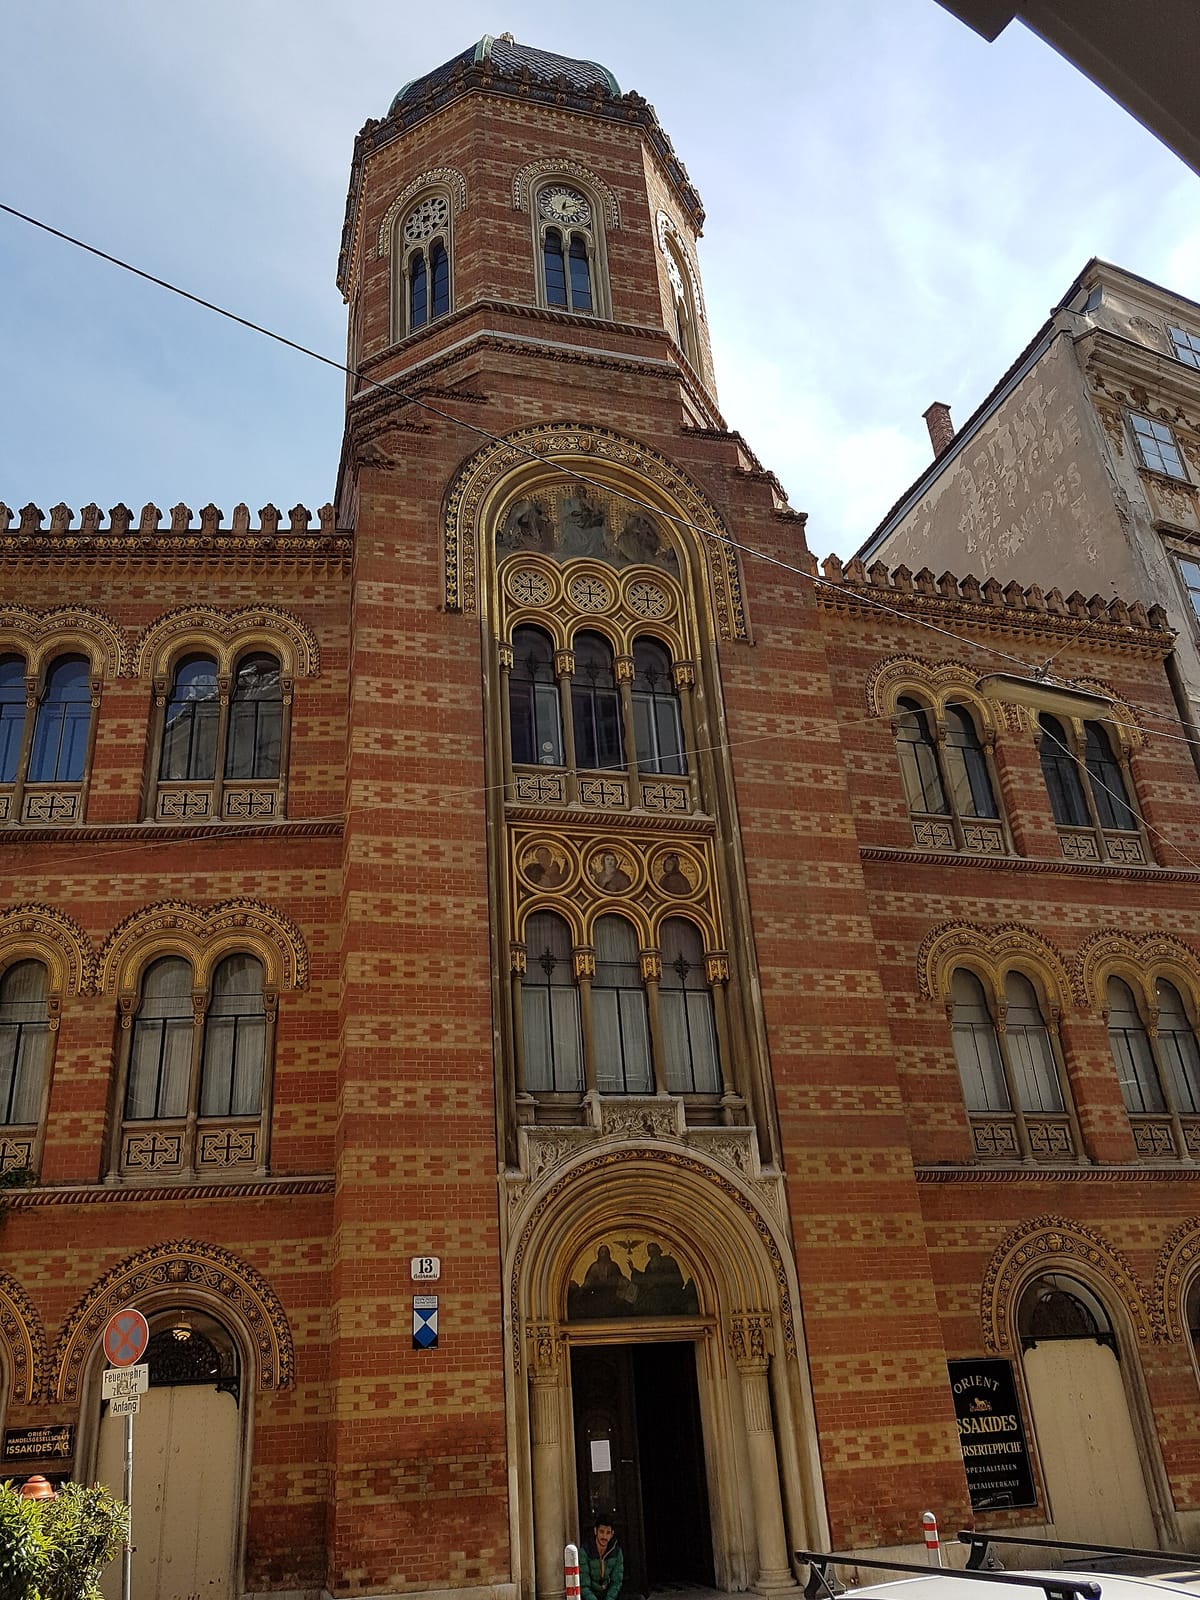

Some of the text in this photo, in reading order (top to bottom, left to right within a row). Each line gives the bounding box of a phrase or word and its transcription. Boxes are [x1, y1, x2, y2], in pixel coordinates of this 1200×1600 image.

[419, 1259, 433, 1273] 13
[953, 1375, 1000, 1394] ORIENT
[113, 1401, 137, 1413] Anfang
[6, 1444, 52, 1455] ISSAKIDES
[961, 1442, 1022, 1456] RSERTEPPICHE
